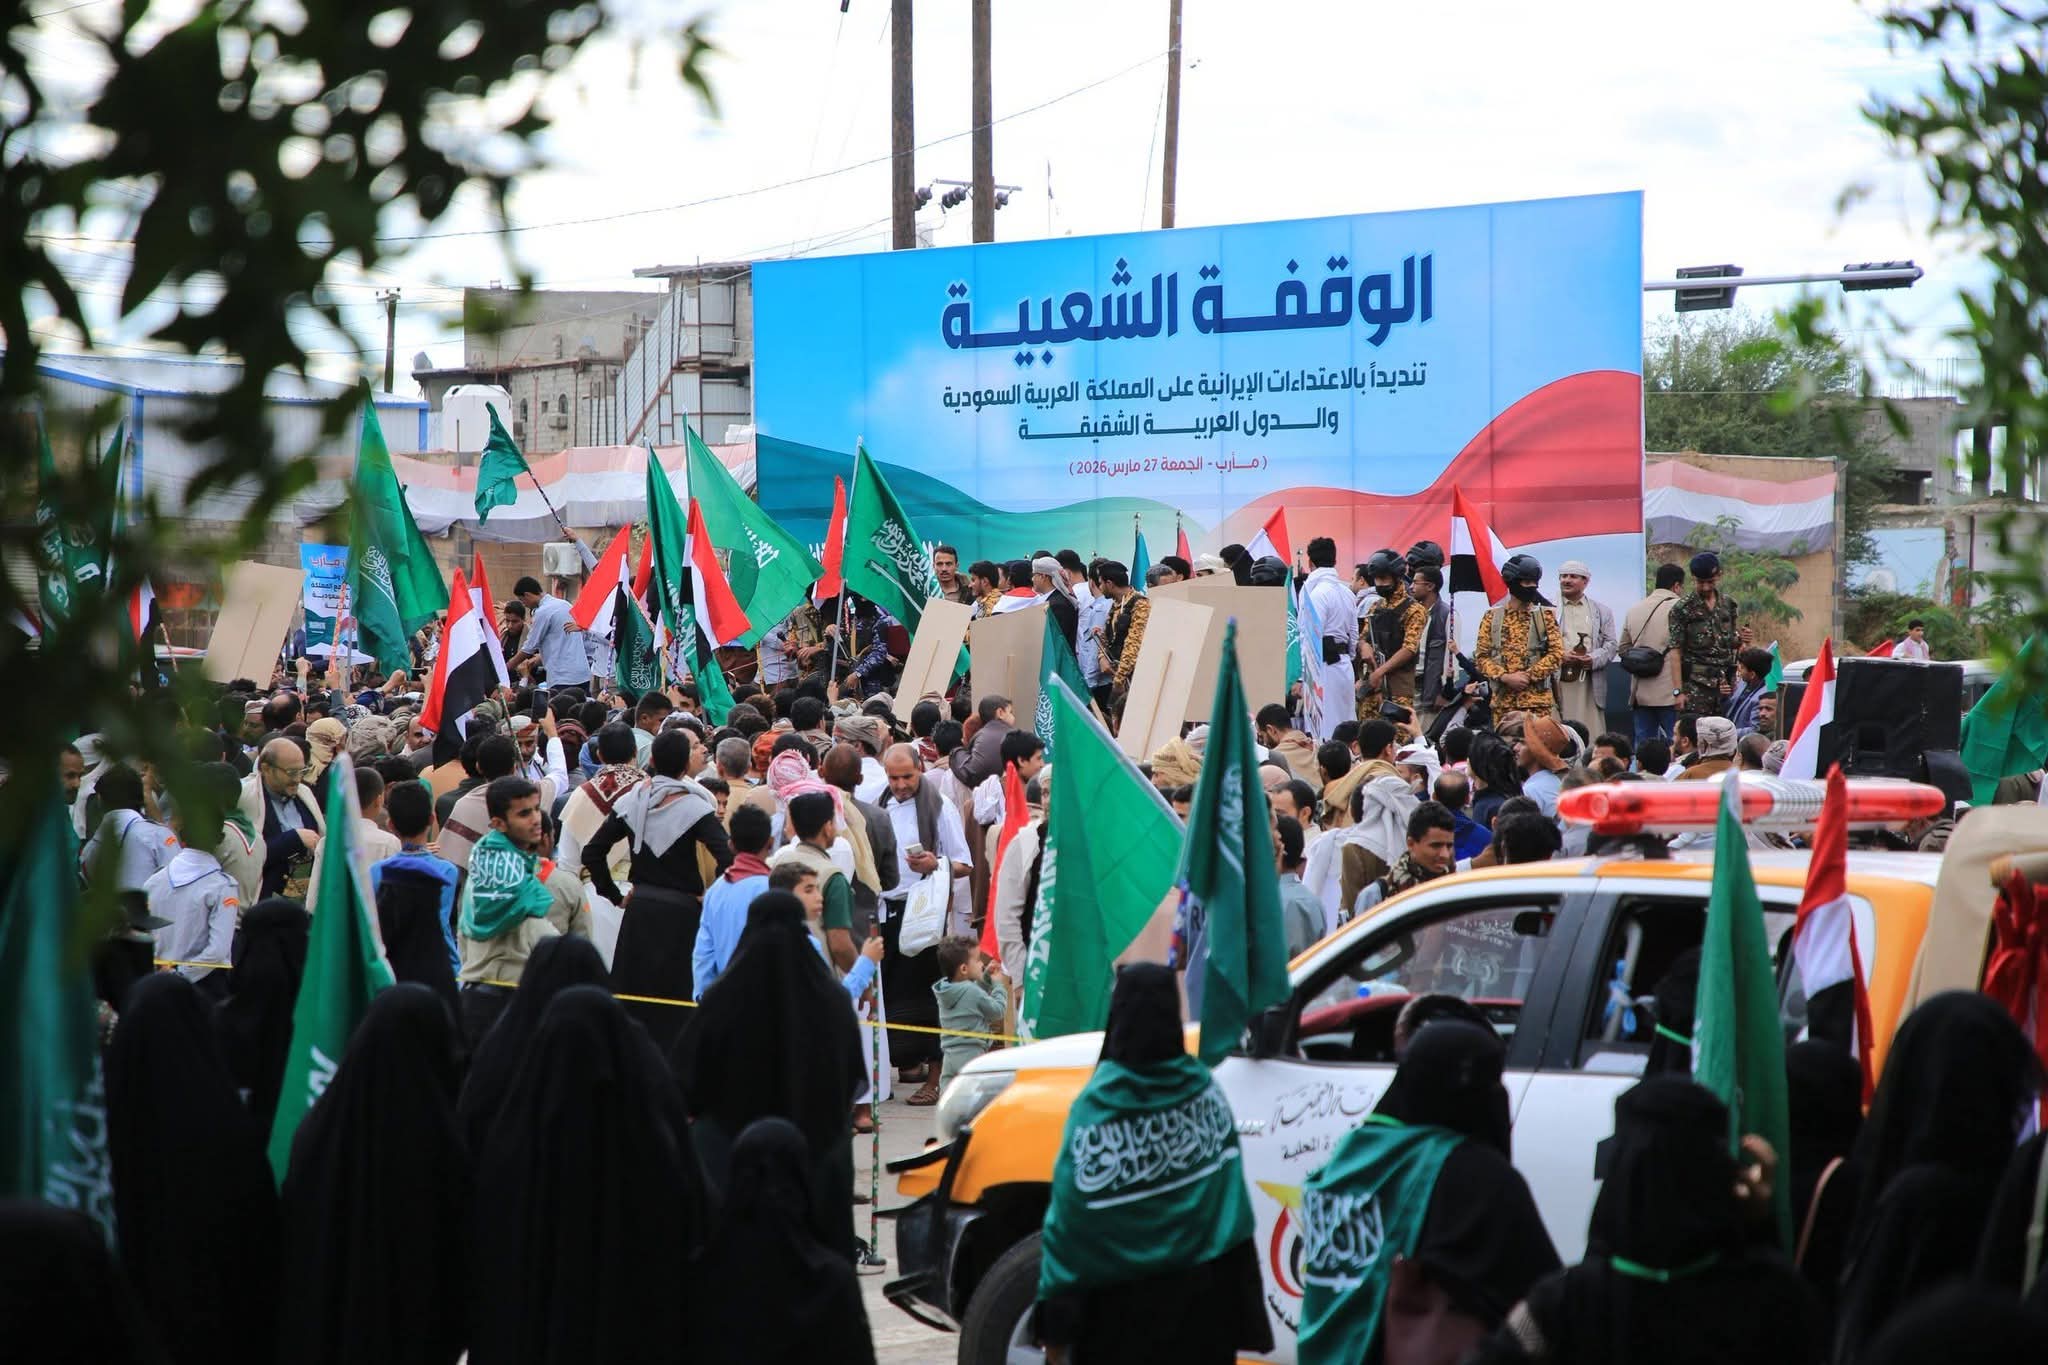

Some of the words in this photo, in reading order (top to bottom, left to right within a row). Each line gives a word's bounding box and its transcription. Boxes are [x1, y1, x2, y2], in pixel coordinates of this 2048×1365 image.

[941, 257, 1179, 366] الشعبية
[1191, 253, 1433, 347] الوقفة
[1024, 381, 1080, 410] العربية
[1085, 376, 1154, 401] المملكة
[1157, 376, 1194, 402] على
[1197, 371, 1264, 400] الإيرانية
[1266, 366, 1366, 396] بالاعتداءات
[942, 384, 1022, 413] السعودية
[1017, 409, 1140, 443] الشقيقة
[1143, 409, 1240, 440] العربية
[1242, 406, 1339, 437] والدول
[1143, 458, 1158, 472] 27
[1161, 456, 1203, 474] الجمعة
